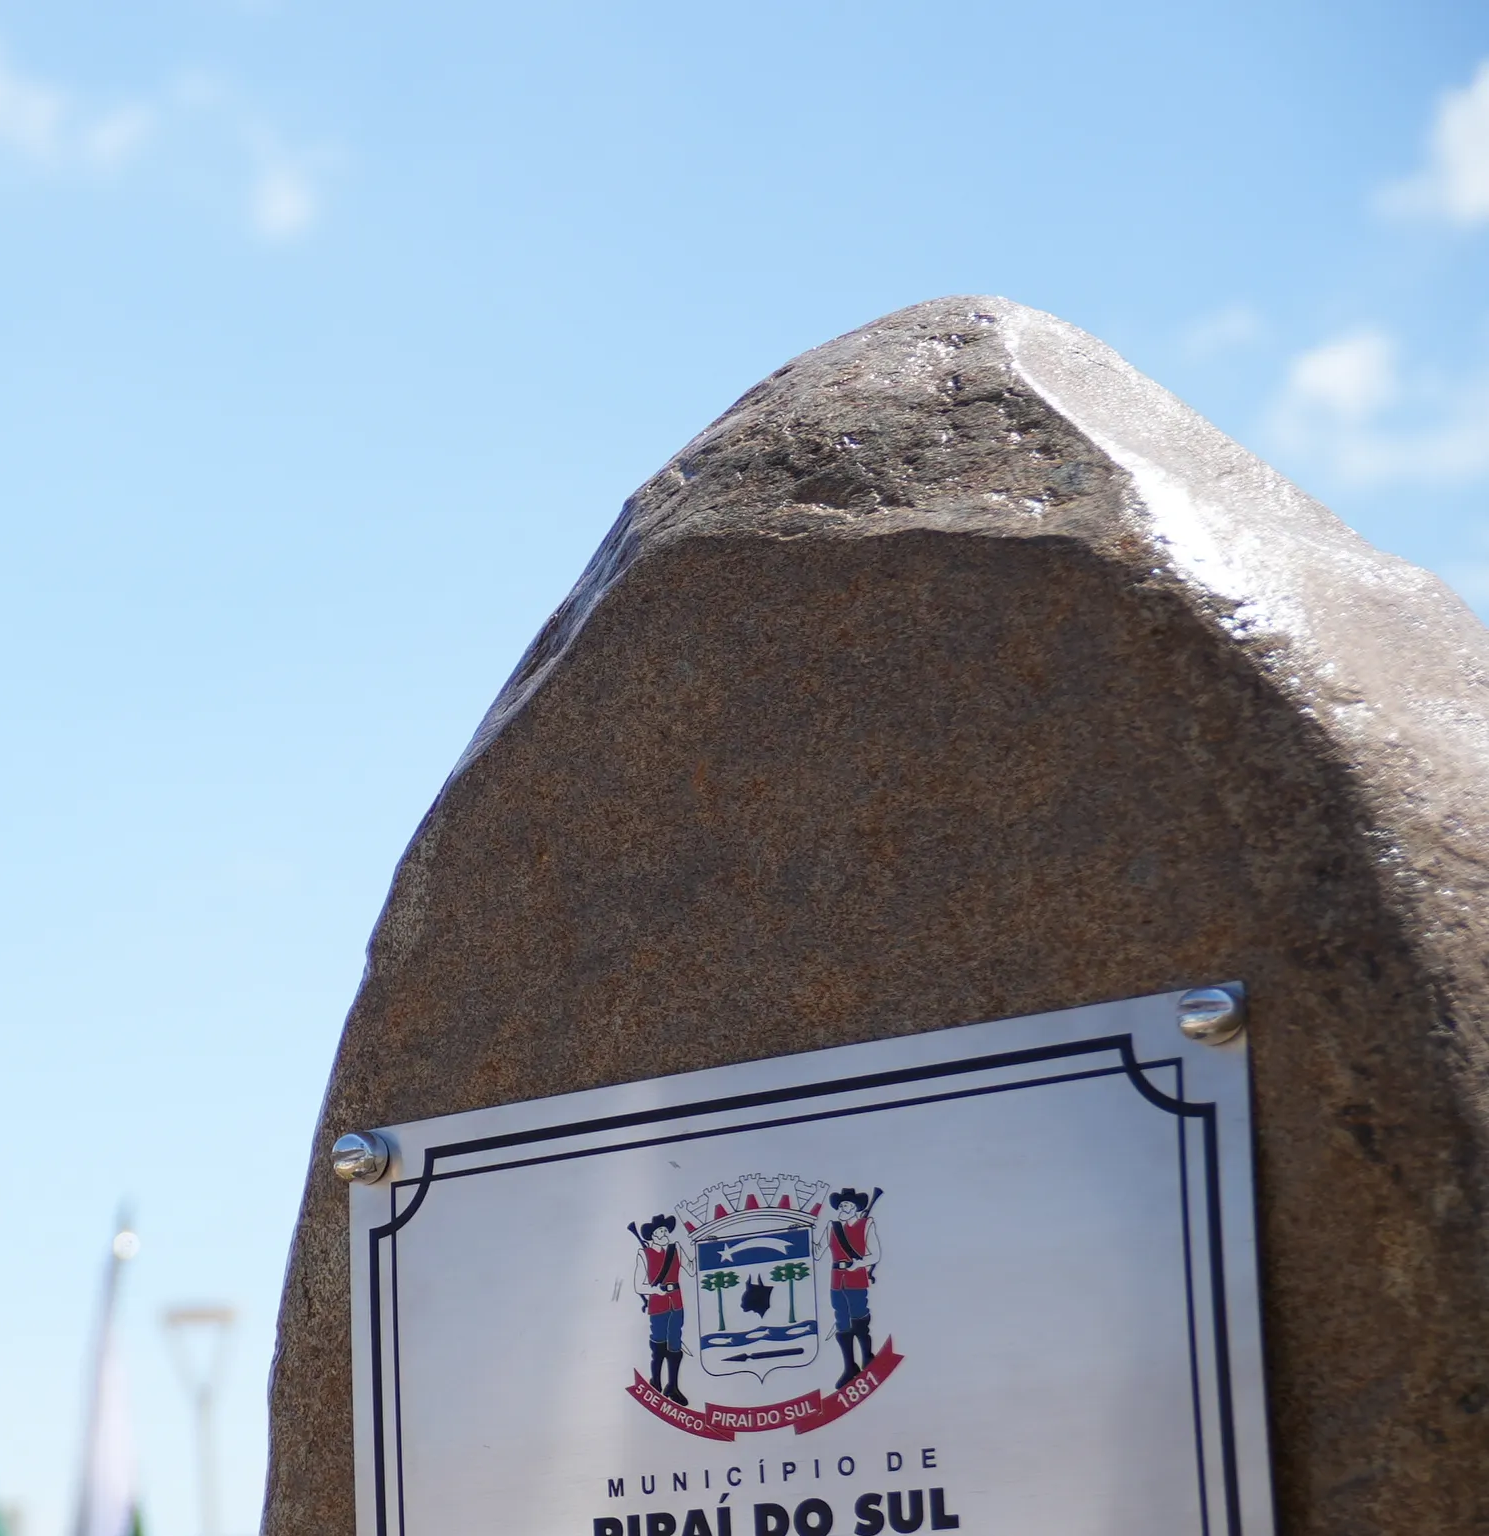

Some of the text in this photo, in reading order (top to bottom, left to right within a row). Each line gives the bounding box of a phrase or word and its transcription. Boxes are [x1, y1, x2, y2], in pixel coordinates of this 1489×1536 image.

[836, 1371, 879, 1408] 1881
[643, 1390, 659, 1407] DE
[660, 1403, 704, 1432] MARÇO
[757, 1410, 780, 1426] DO
[784, 1400, 817, 1420] SUL
[608, 1448, 937, 1497] MUNICÍPIO DE
[854, 1487, 959, 1536] SUL
